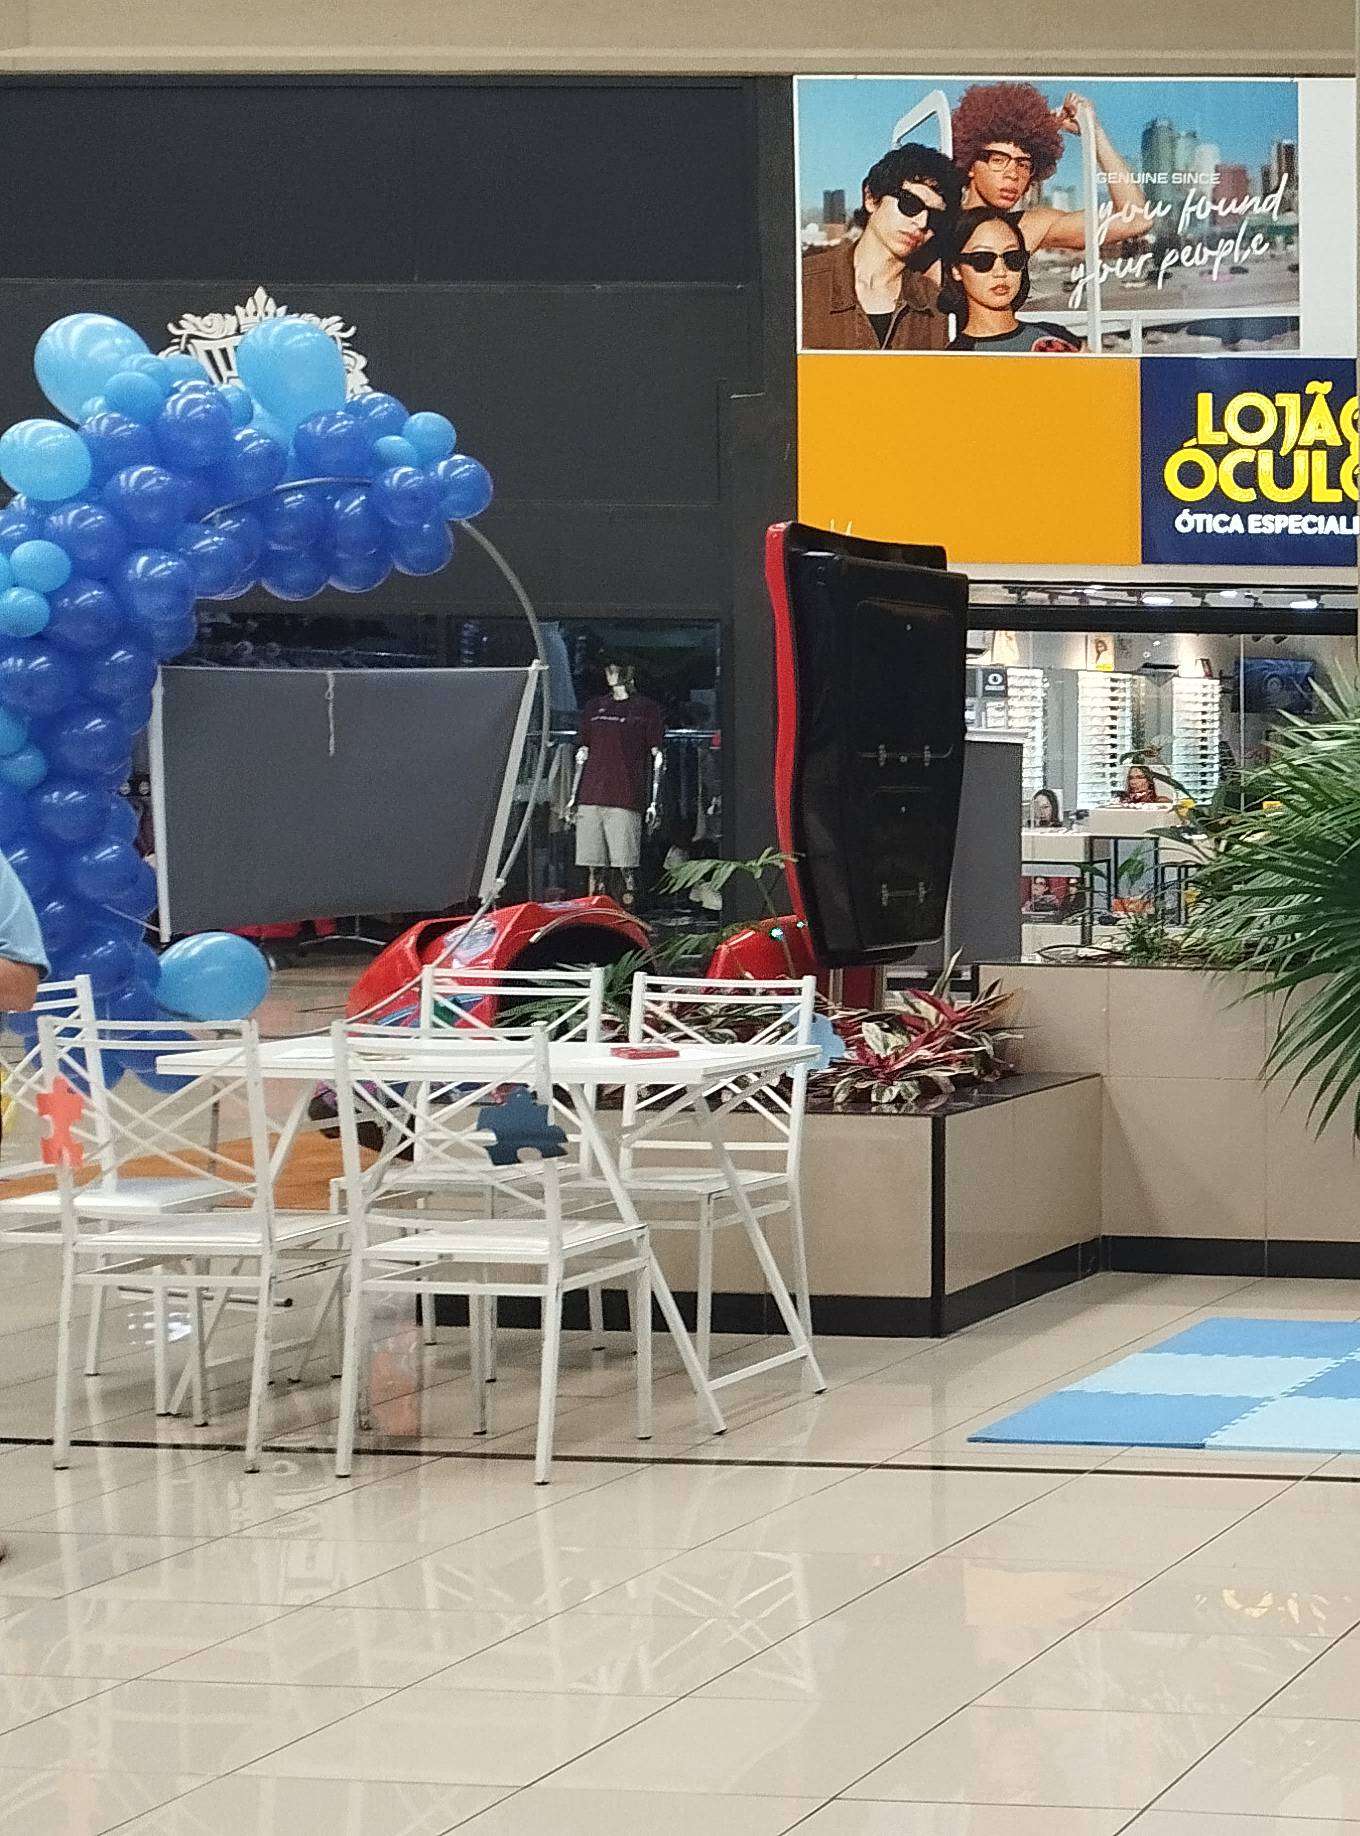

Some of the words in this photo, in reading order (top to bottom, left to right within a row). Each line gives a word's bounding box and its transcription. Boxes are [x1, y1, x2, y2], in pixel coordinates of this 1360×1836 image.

[1097, 172, 1168, 185] GENUINE
[1171, 172, 1221, 185] SINCE
[1097, 200, 1172, 246] you
[1176, 173, 1288, 236] found
[1067, 251, 1154, 309] your
[1156, 220, 1270, 290] people
[1174, 508, 1245, 535] ÓTICA
